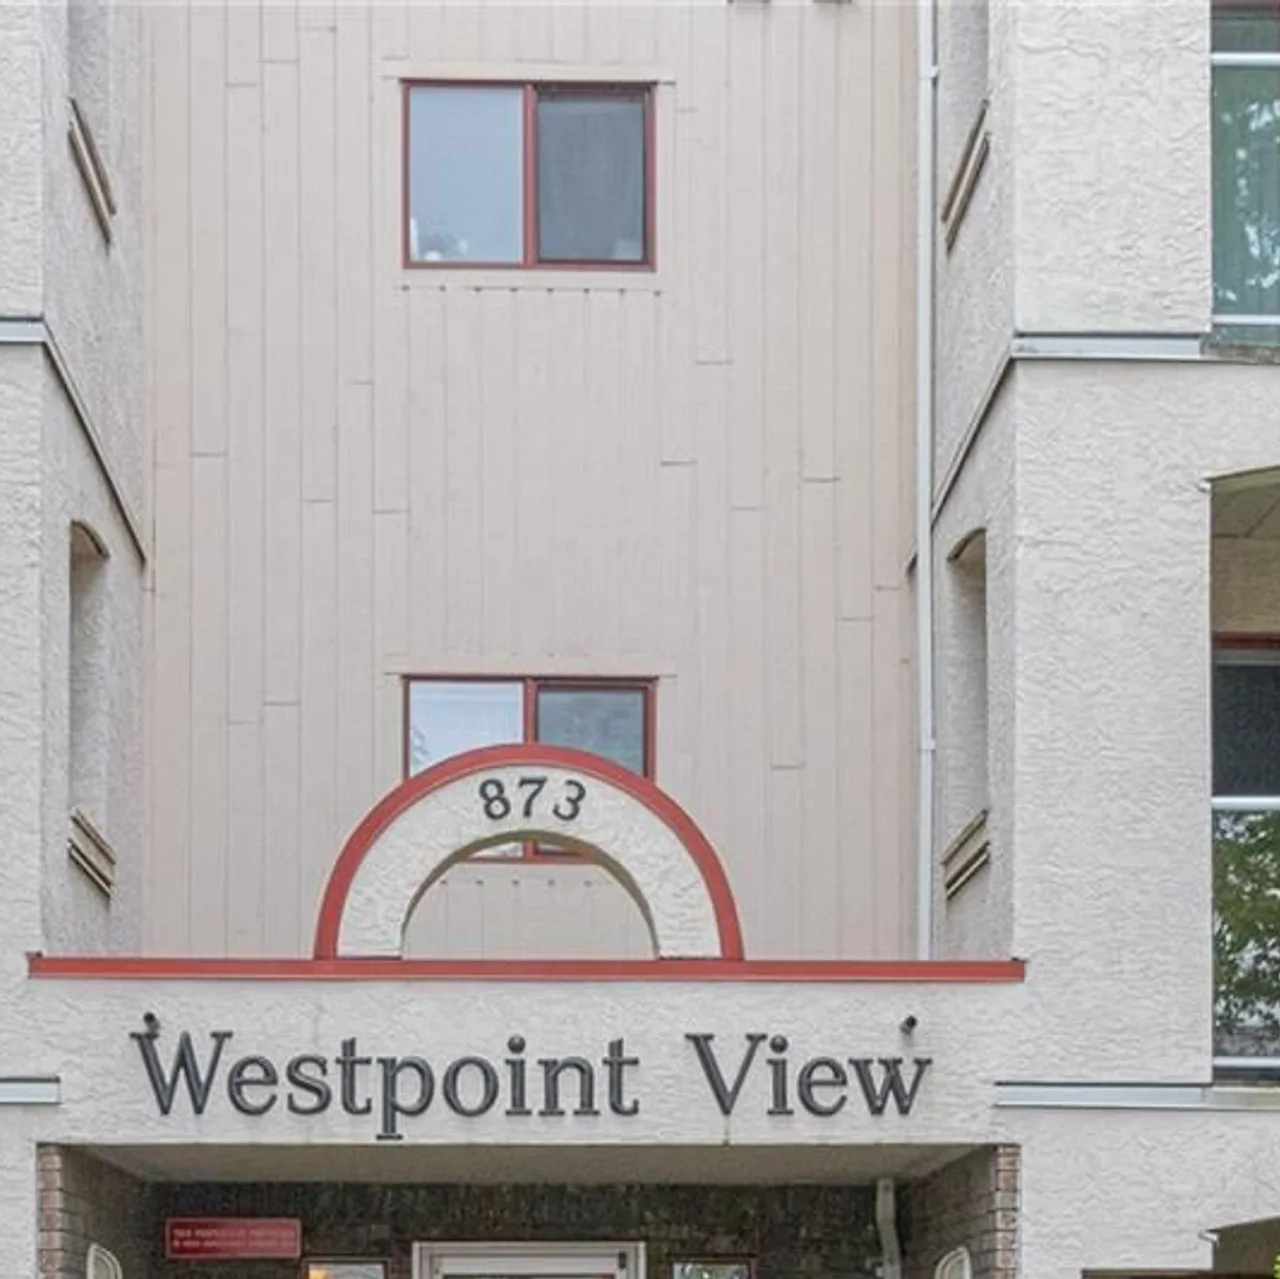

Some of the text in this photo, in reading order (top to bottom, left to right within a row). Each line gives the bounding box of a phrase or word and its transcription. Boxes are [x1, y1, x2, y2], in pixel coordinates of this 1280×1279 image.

[479, 776, 587, 820] 873
[129, 1031, 933, 1140] Westpoint View
